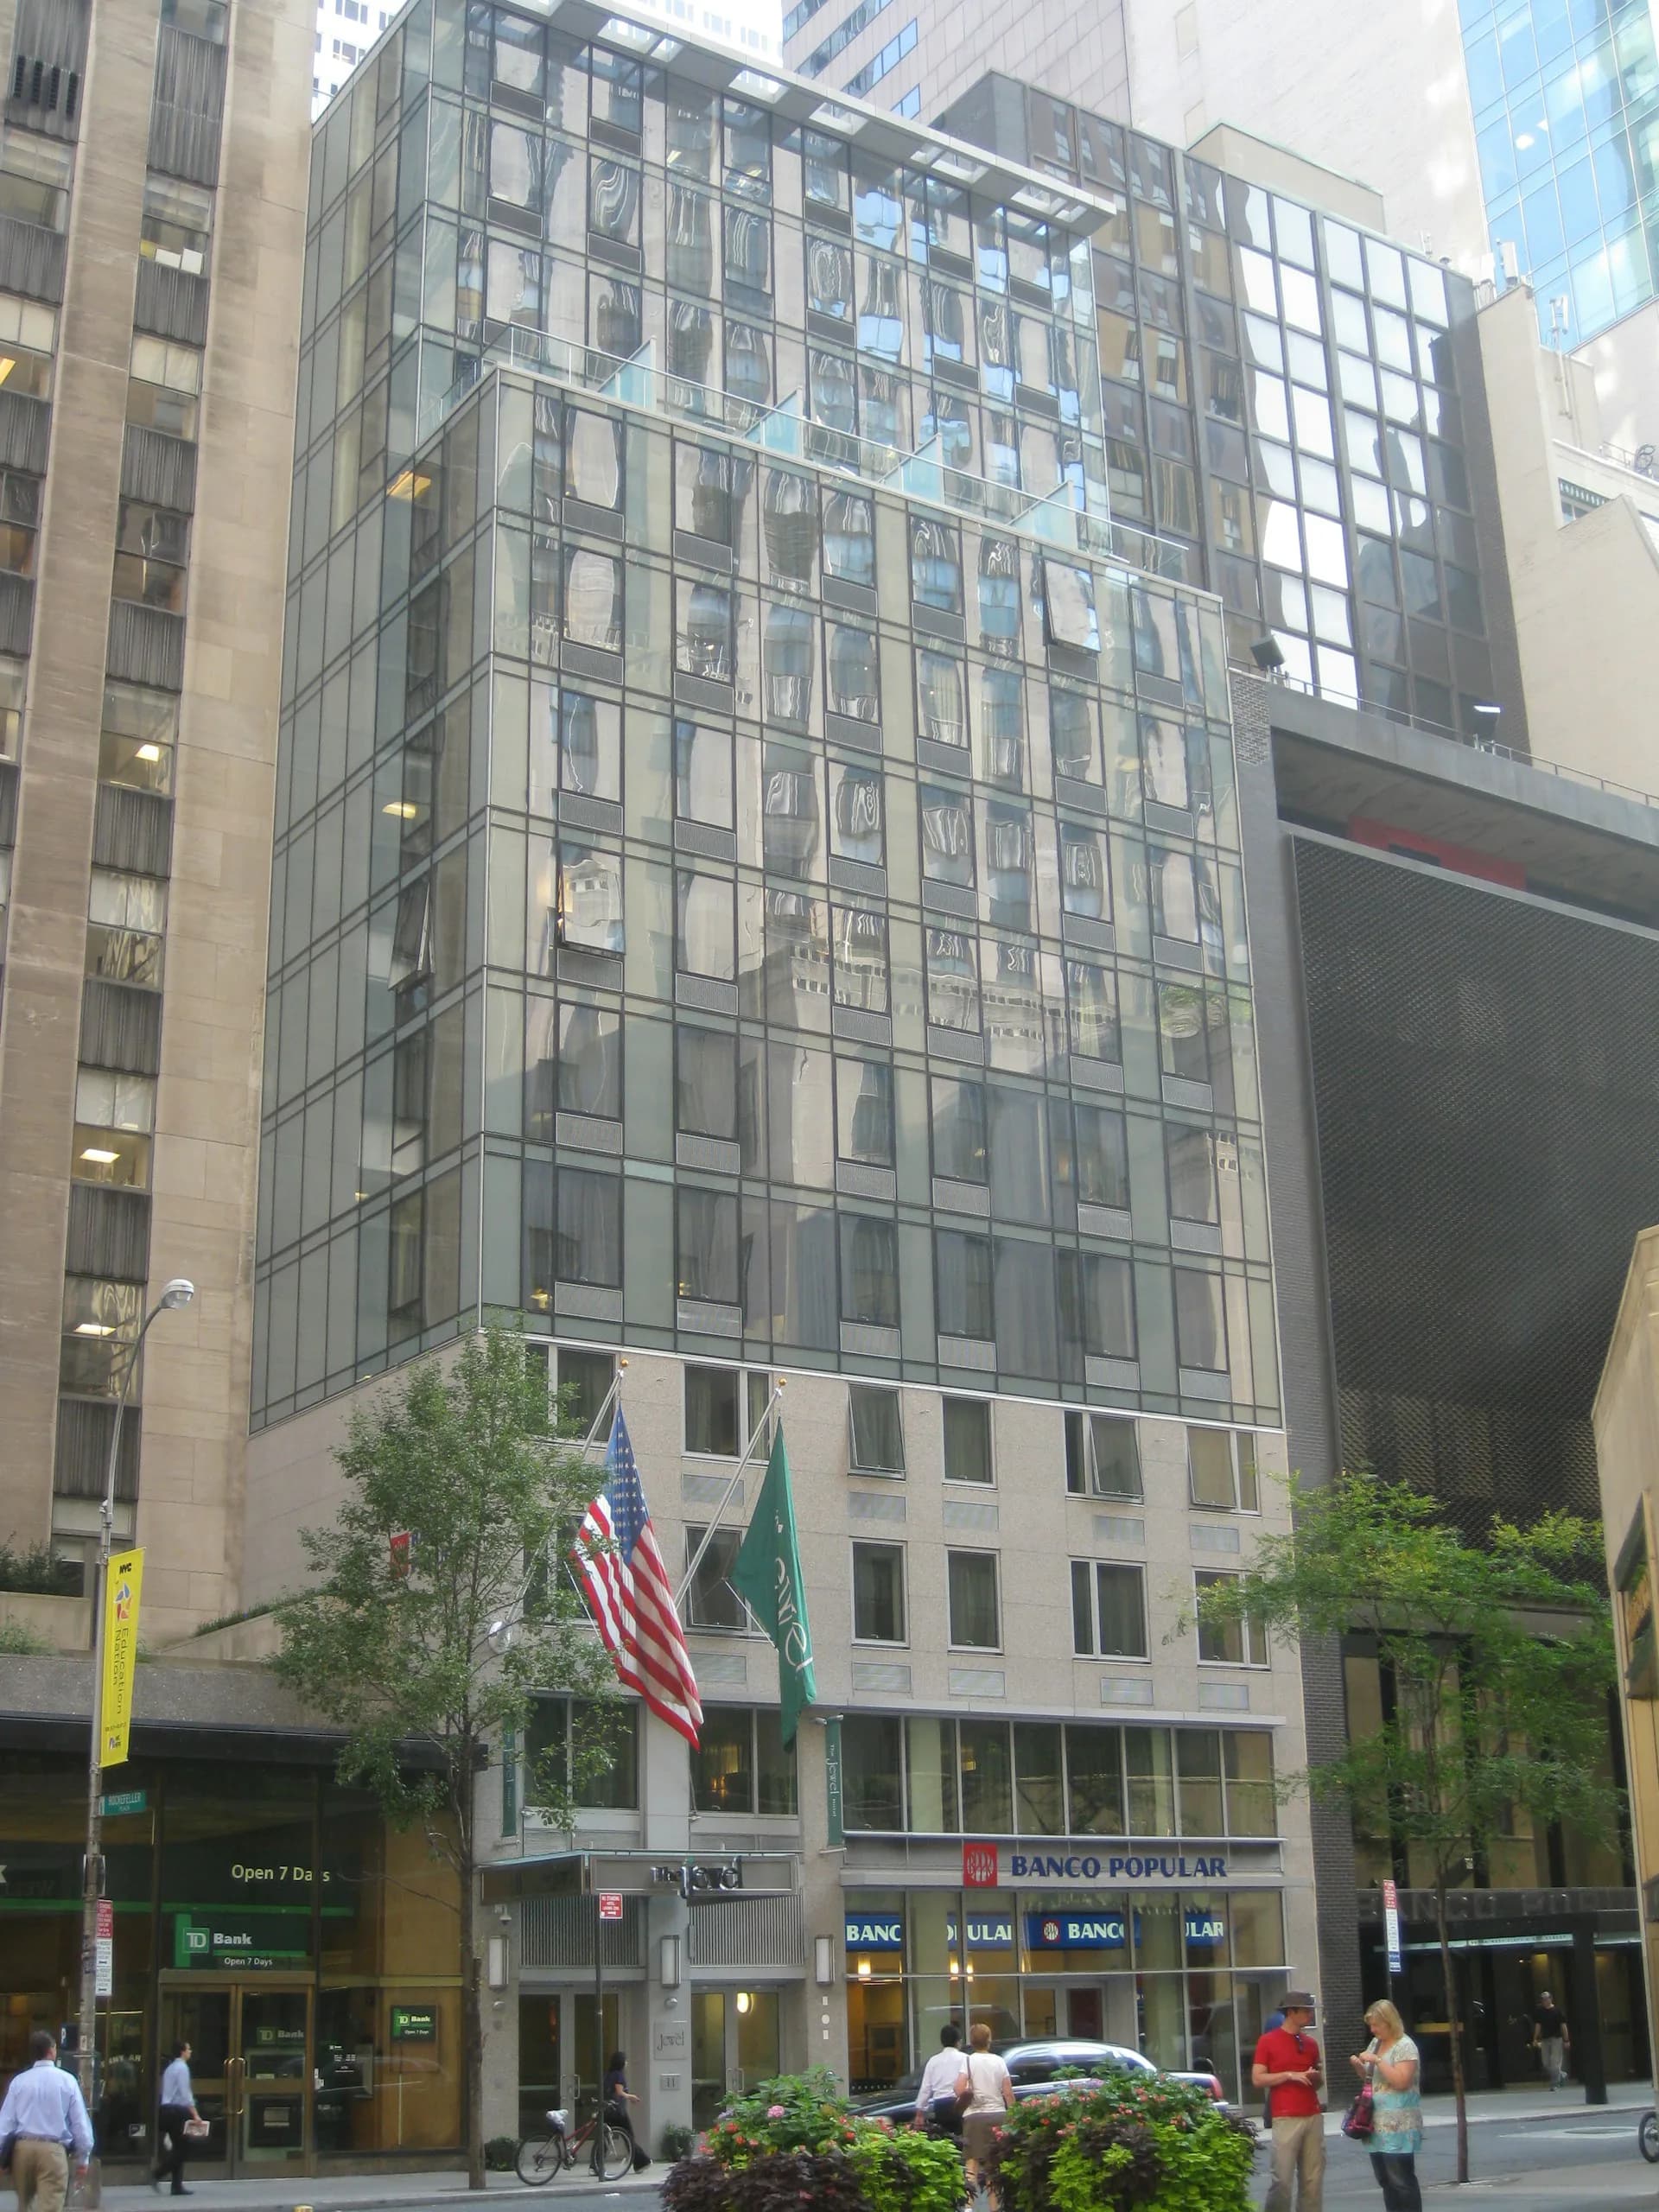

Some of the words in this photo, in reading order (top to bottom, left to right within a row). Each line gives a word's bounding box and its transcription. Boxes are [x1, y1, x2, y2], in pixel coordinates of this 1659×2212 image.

[119, 1562, 132, 1574] NYC
[112, 1630, 122, 1686] Nation
[117, 1627, 129, 1714] Education
[108, 1792, 141, 1806] ROCKEFELLER
[232, 1864, 274, 1882] Open
[279, 1866, 289, 1880] 7
[293, 1866, 330, 1882] Das
[1011, 1855, 1102, 1878] BANCO
[1109, 1857, 1228, 1878] POPULAR
[186, 1932, 207, 1948] TD
[213, 1933, 252, 1945] Bank
[225, 1957, 245, 1966] Open
[254, 1957, 273, 1966] Days
[397, 2015, 409, 2024] TD
[260, 2030, 274, 2040] TD
[277, 2030, 304, 2038] Bank
